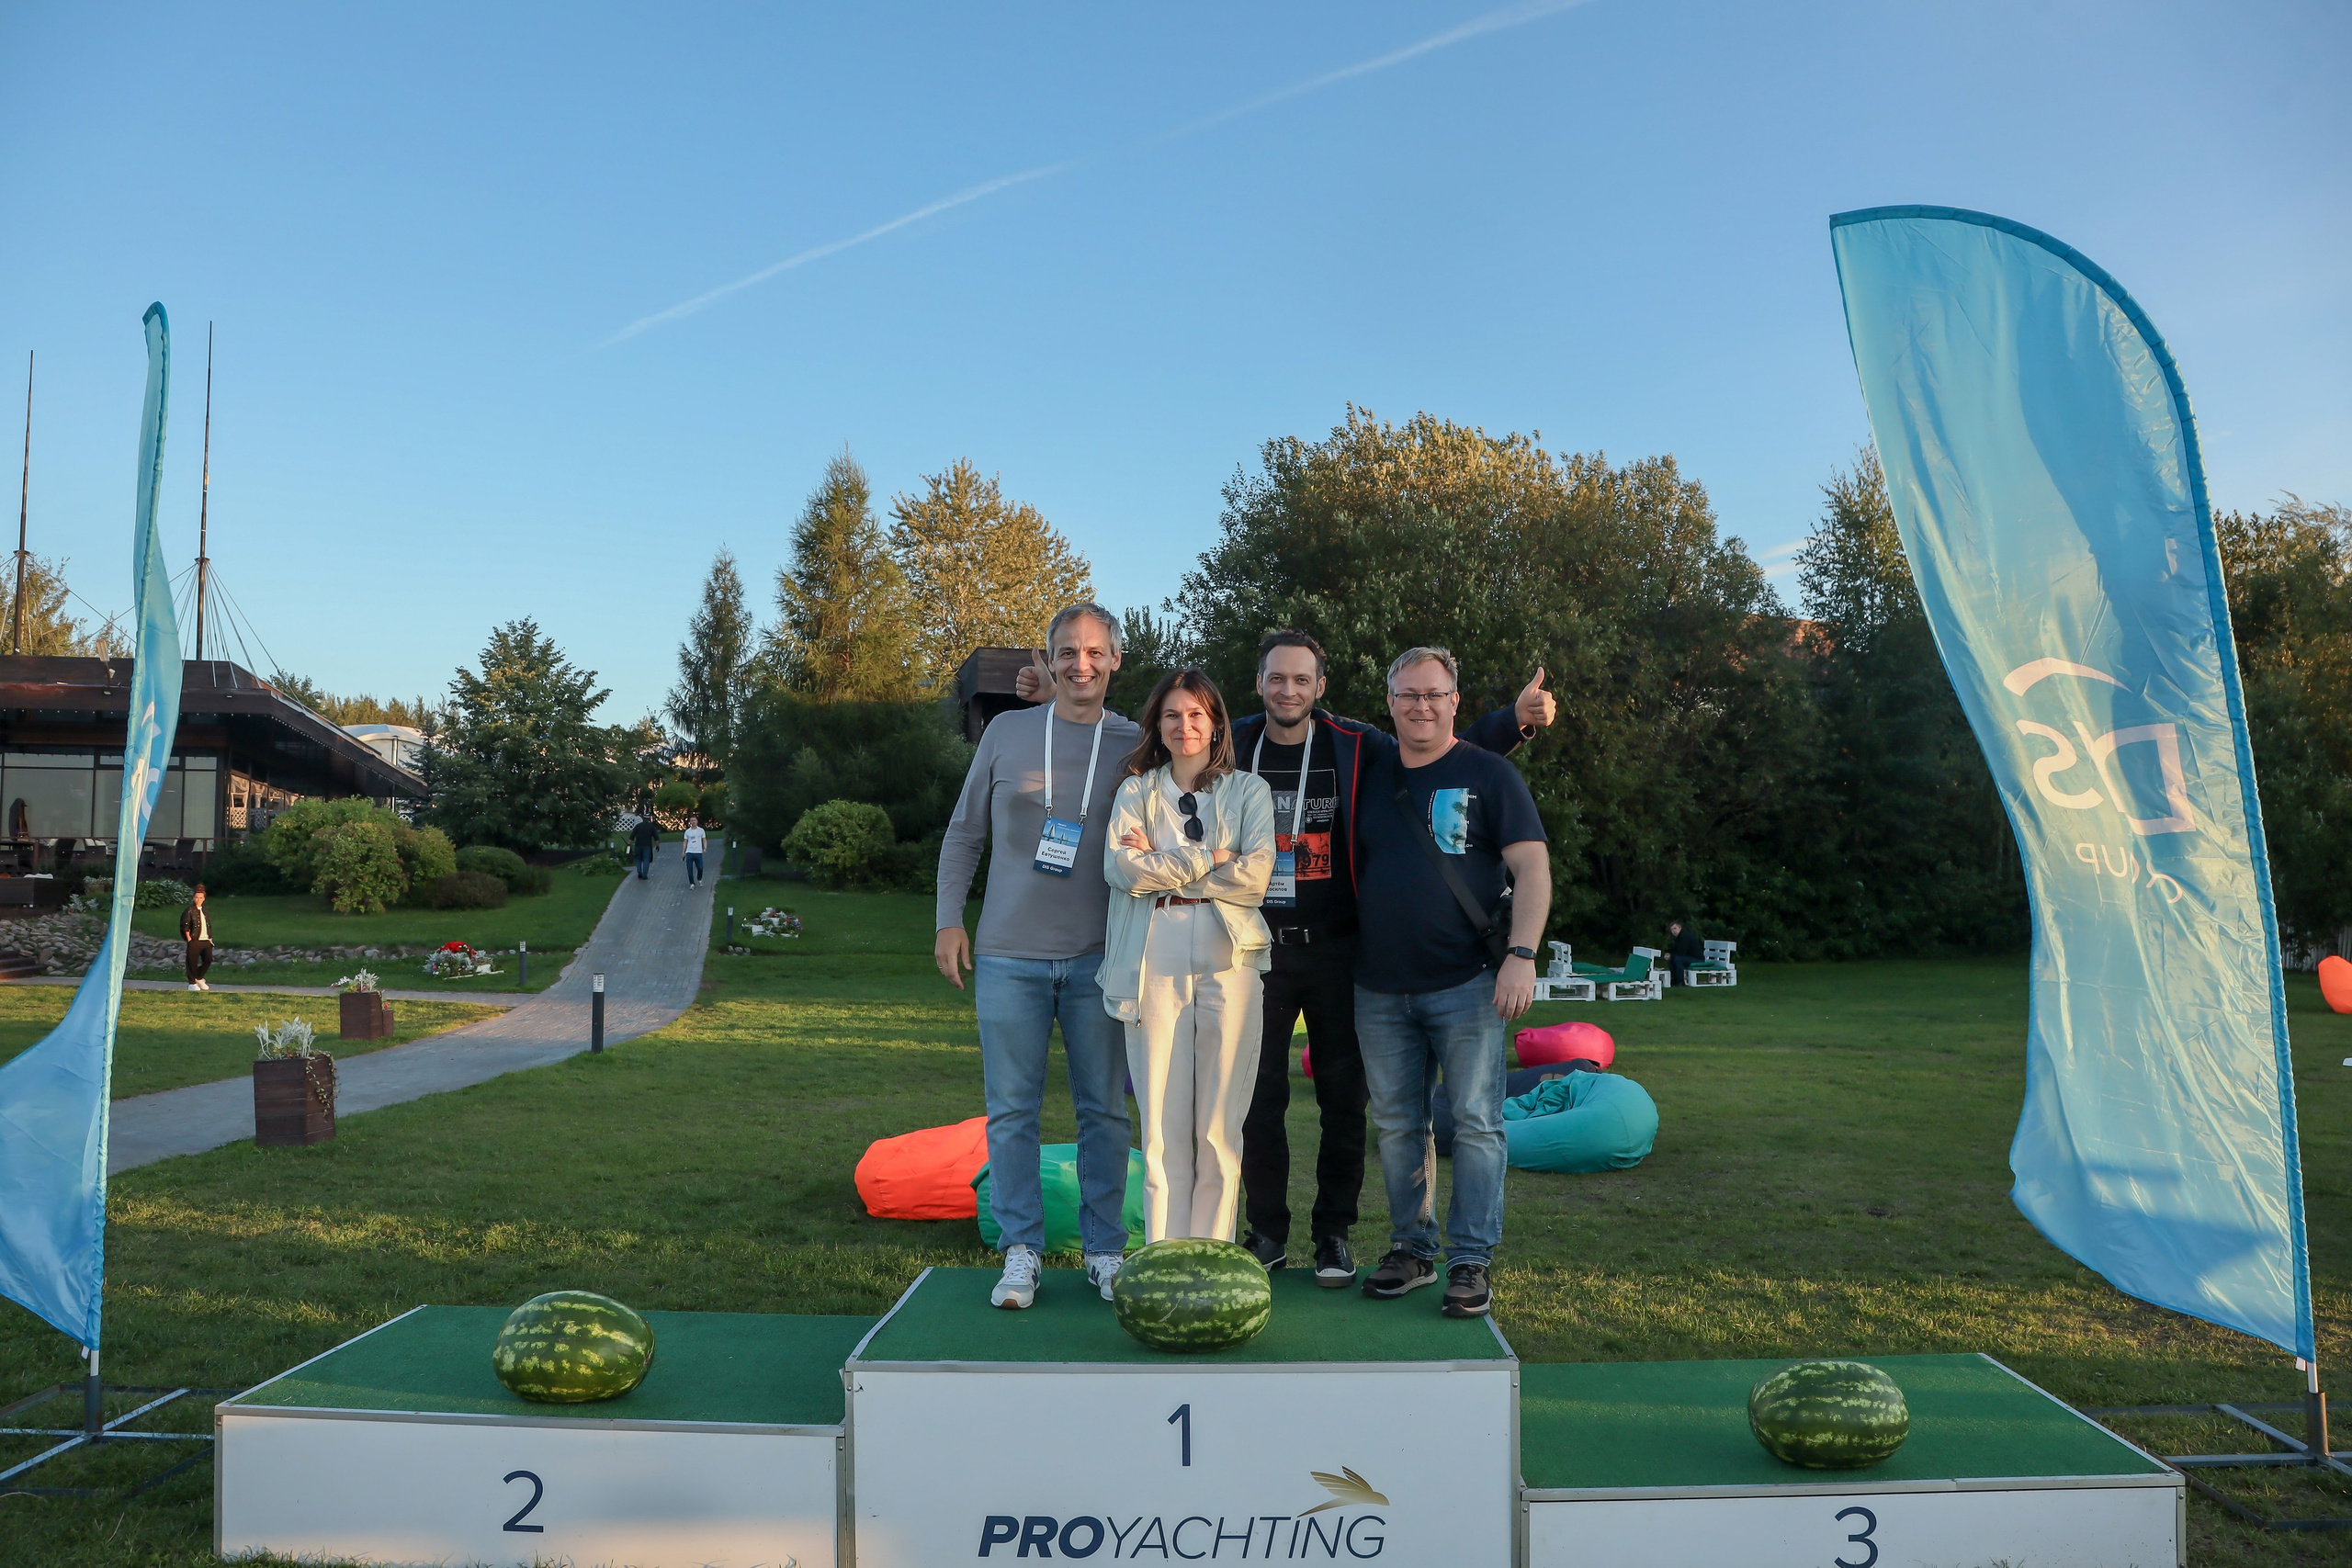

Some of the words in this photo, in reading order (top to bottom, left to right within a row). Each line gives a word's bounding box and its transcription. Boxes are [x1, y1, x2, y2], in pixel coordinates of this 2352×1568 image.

[1041, 851, 1069, 861] Евтушенко
[1167, 1404, 1191, 1466] 1
[503, 1471, 543, 1532] 2
[978, 1515, 1386, 1559] PROYACHTING
[1834, 1506, 1878, 1568] 3
